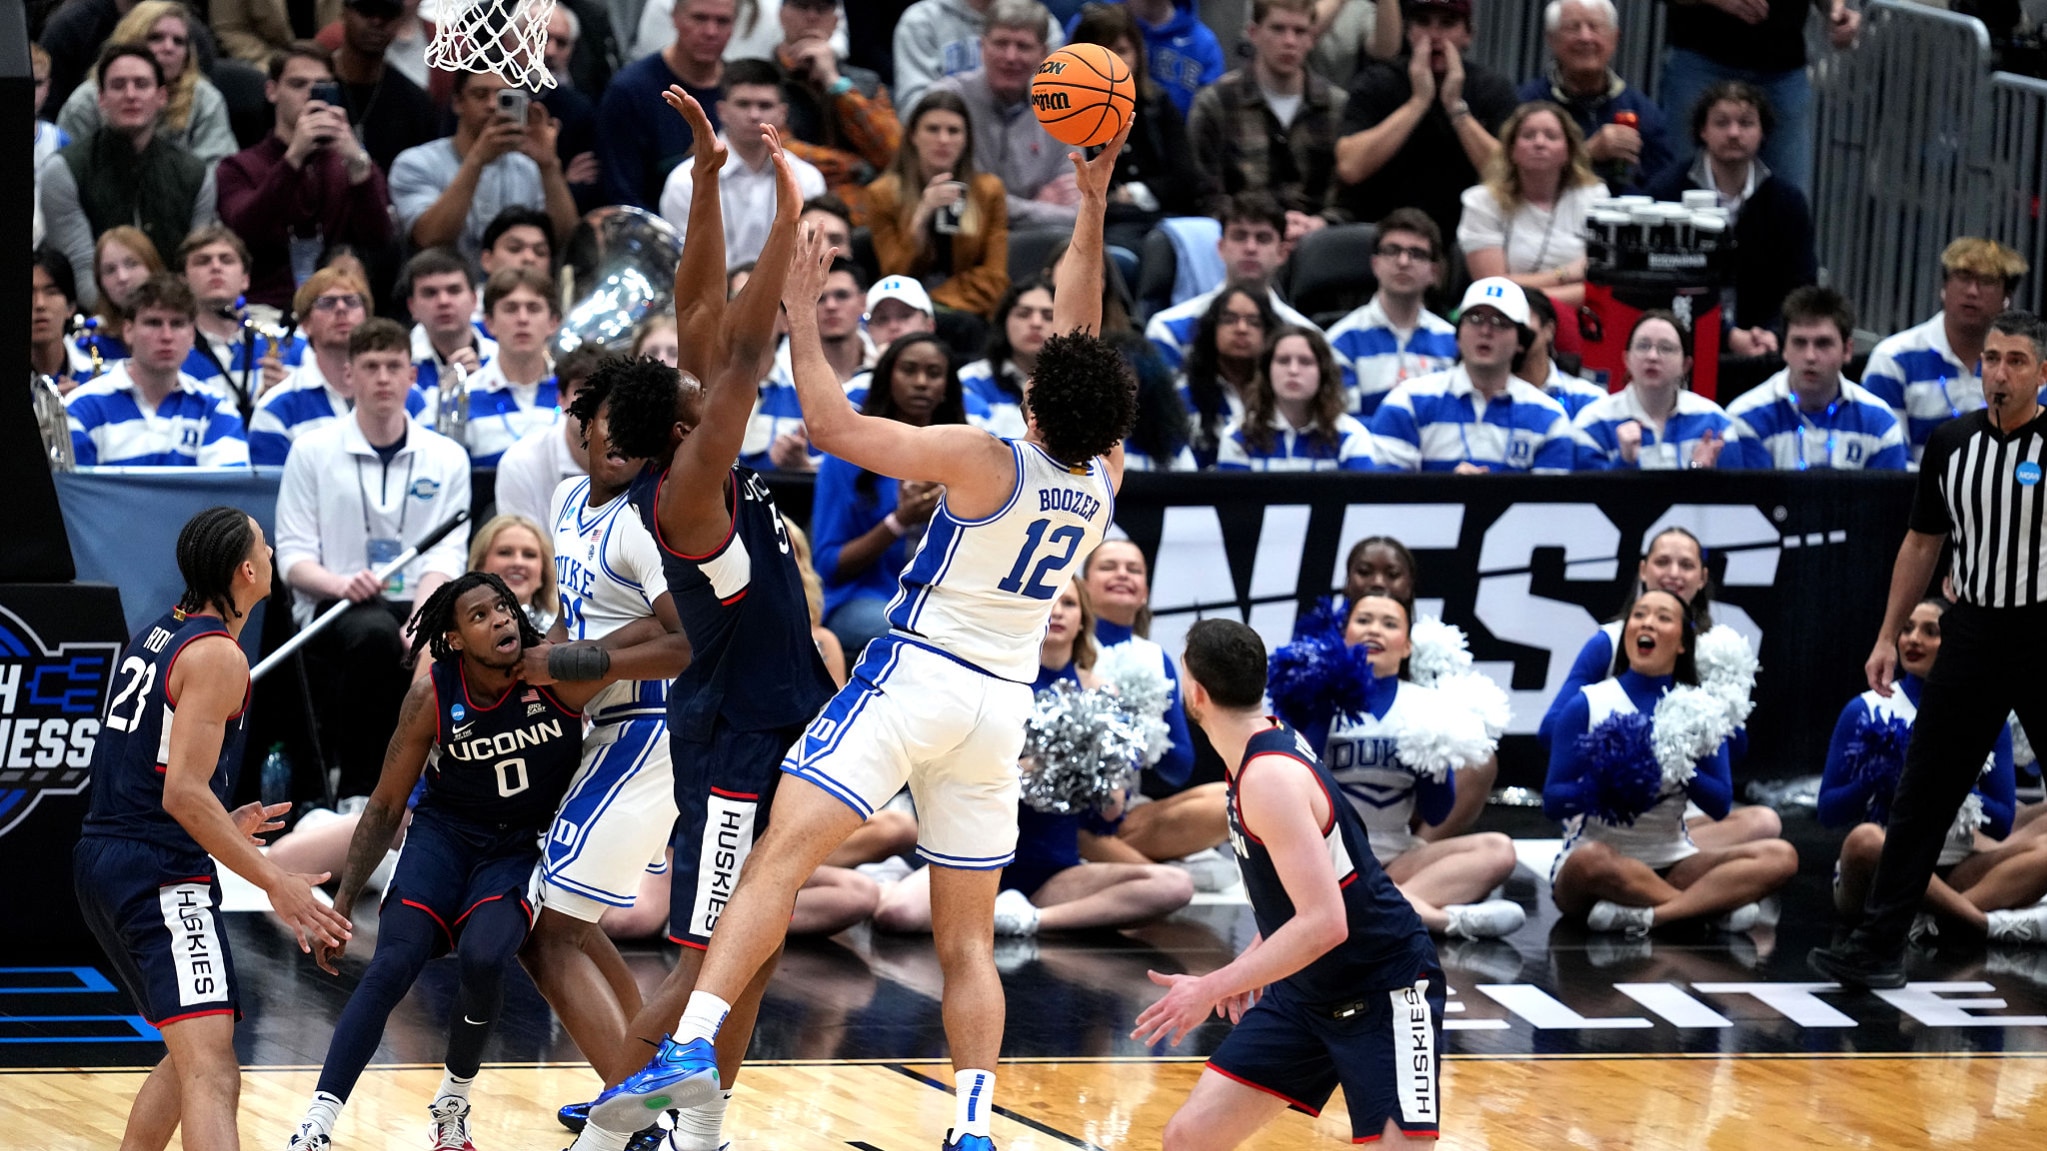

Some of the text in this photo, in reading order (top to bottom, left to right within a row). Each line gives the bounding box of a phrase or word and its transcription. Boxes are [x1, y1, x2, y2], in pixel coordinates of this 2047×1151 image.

[1035, 61, 1067, 75] NCA
[1031, 92, 1071, 111] Wilso
[1038, 488, 1101, 522] BOOZER
[997, 518, 1086, 600] 12
[106, 656, 157, 734] 23
[448, 718, 563, 761] UCONN
[807, 717, 838, 742] D
[1332, 738, 1403, 770] DUK
[494, 757, 530, 798] 0
[553, 817, 579, 847] D
[705, 809, 742, 932] HUSKIES
[176, 890, 215, 995] HUSKIES
[1404, 987, 1431, 1114] HUSKIES
